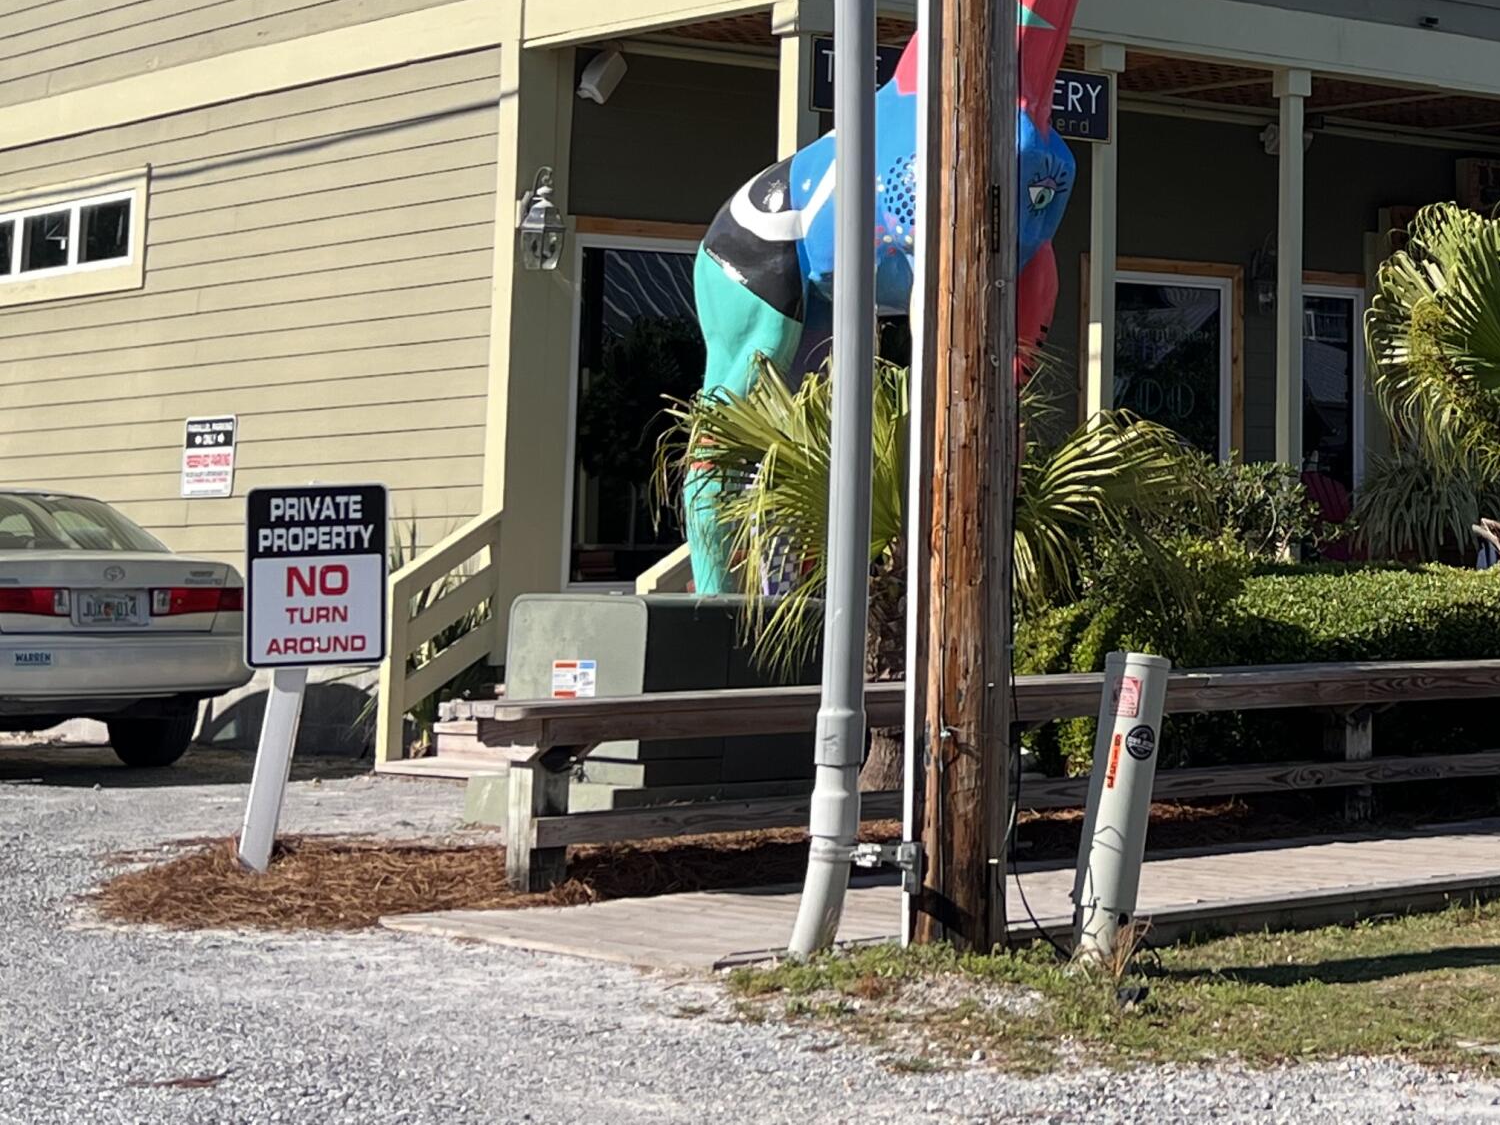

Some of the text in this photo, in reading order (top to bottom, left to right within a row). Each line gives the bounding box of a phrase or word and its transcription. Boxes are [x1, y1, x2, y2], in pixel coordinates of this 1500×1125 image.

[270, 495, 362, 522] PRIVATE
[258, 524, 374, 552] PROPERTY
[286, 564, 349, 597] NO
[285, 605, 348, 624] TURN
[266, 635, 366, 656] AROUND
